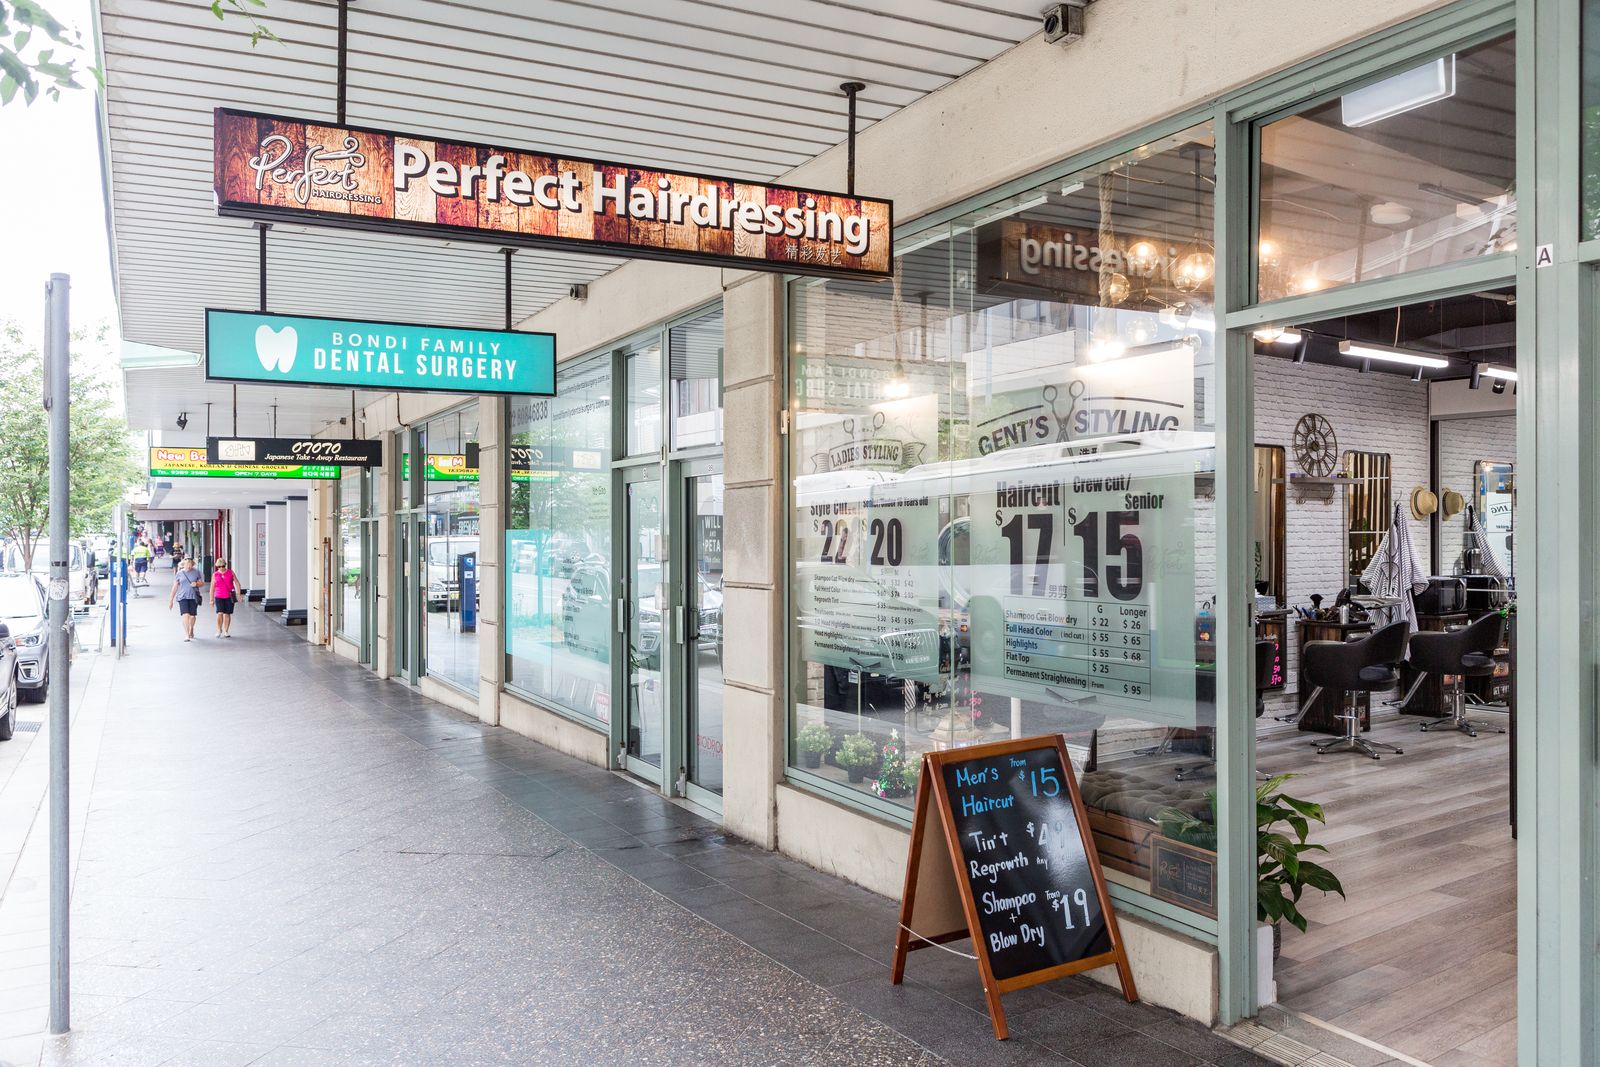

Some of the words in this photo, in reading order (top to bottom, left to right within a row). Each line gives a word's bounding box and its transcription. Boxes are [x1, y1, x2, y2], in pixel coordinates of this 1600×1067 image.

[249, 135, 359, 204] Perfect
[312, 189, 382, 204] HAIRDRESSING
[394, 144, 582, 213] Perfect
[593, 170, 870, 255] Hairdressing
[785, 243, 842, 265] 精彩发艺
[1538, 247, 1551, 265] A
[332, 332, 408, 350] BONDI
[421, 338, 501, 356] FAMILY
[314, 348, 404, 374] DENTAL
[416, 354, 517, 380] SURGERY
[978, 416, 1049, 456] GENT'S
[157, 449, 185, 461] New
[264, 453, 294, 462] Japanese
[315, 454, 333, 463] Away
[334, 454, 368, 462] Restaurant
[830, 447, 859, 467] LADIES
[863, 444, 900, 462] STYLING
[996, 480, 1061, 508] Haircut
[1073, 475, 1103, 493] Crew
[1105, 473, 1132, 492] cut/
[1125, 493, 1164, 510] Senior
[705, 516, 721, 528] WILL
[705, 539, 721, 552] PETA
[1005, 610, 1035, 622] Shampoo
[1036, 612, 1047, 621] Cut
[1048, 613, 1064, 624] Blow
[1065, 615, 1077, 626] dry
[1097, 605, 1103, 614] G
[1120, 606, 1147, 619] Longer
[1006, 624, 1017, 633] Full
[1018, 624, 1035, 635] Head
[1035, 626, 1053, 637] Color
[1006, 637, 1038, 650] Highlights
[1006, 651, 1019, 661] Flat
[1019, 653, 1030, 664] Top
[1006, 666, 1040, 680] Permanent
[1040, 671, 1087, 688] Straightening
[956, 766, 999, 787] Men's
[962, 795, 1015, 817] Haircut
[970, 852, 1029, 884] Regrowth
[983, 891, 1037, 915] Shampoo
[990, 932, 1018, 953] Blow
[1020, 923, 1045, 947] Dry
